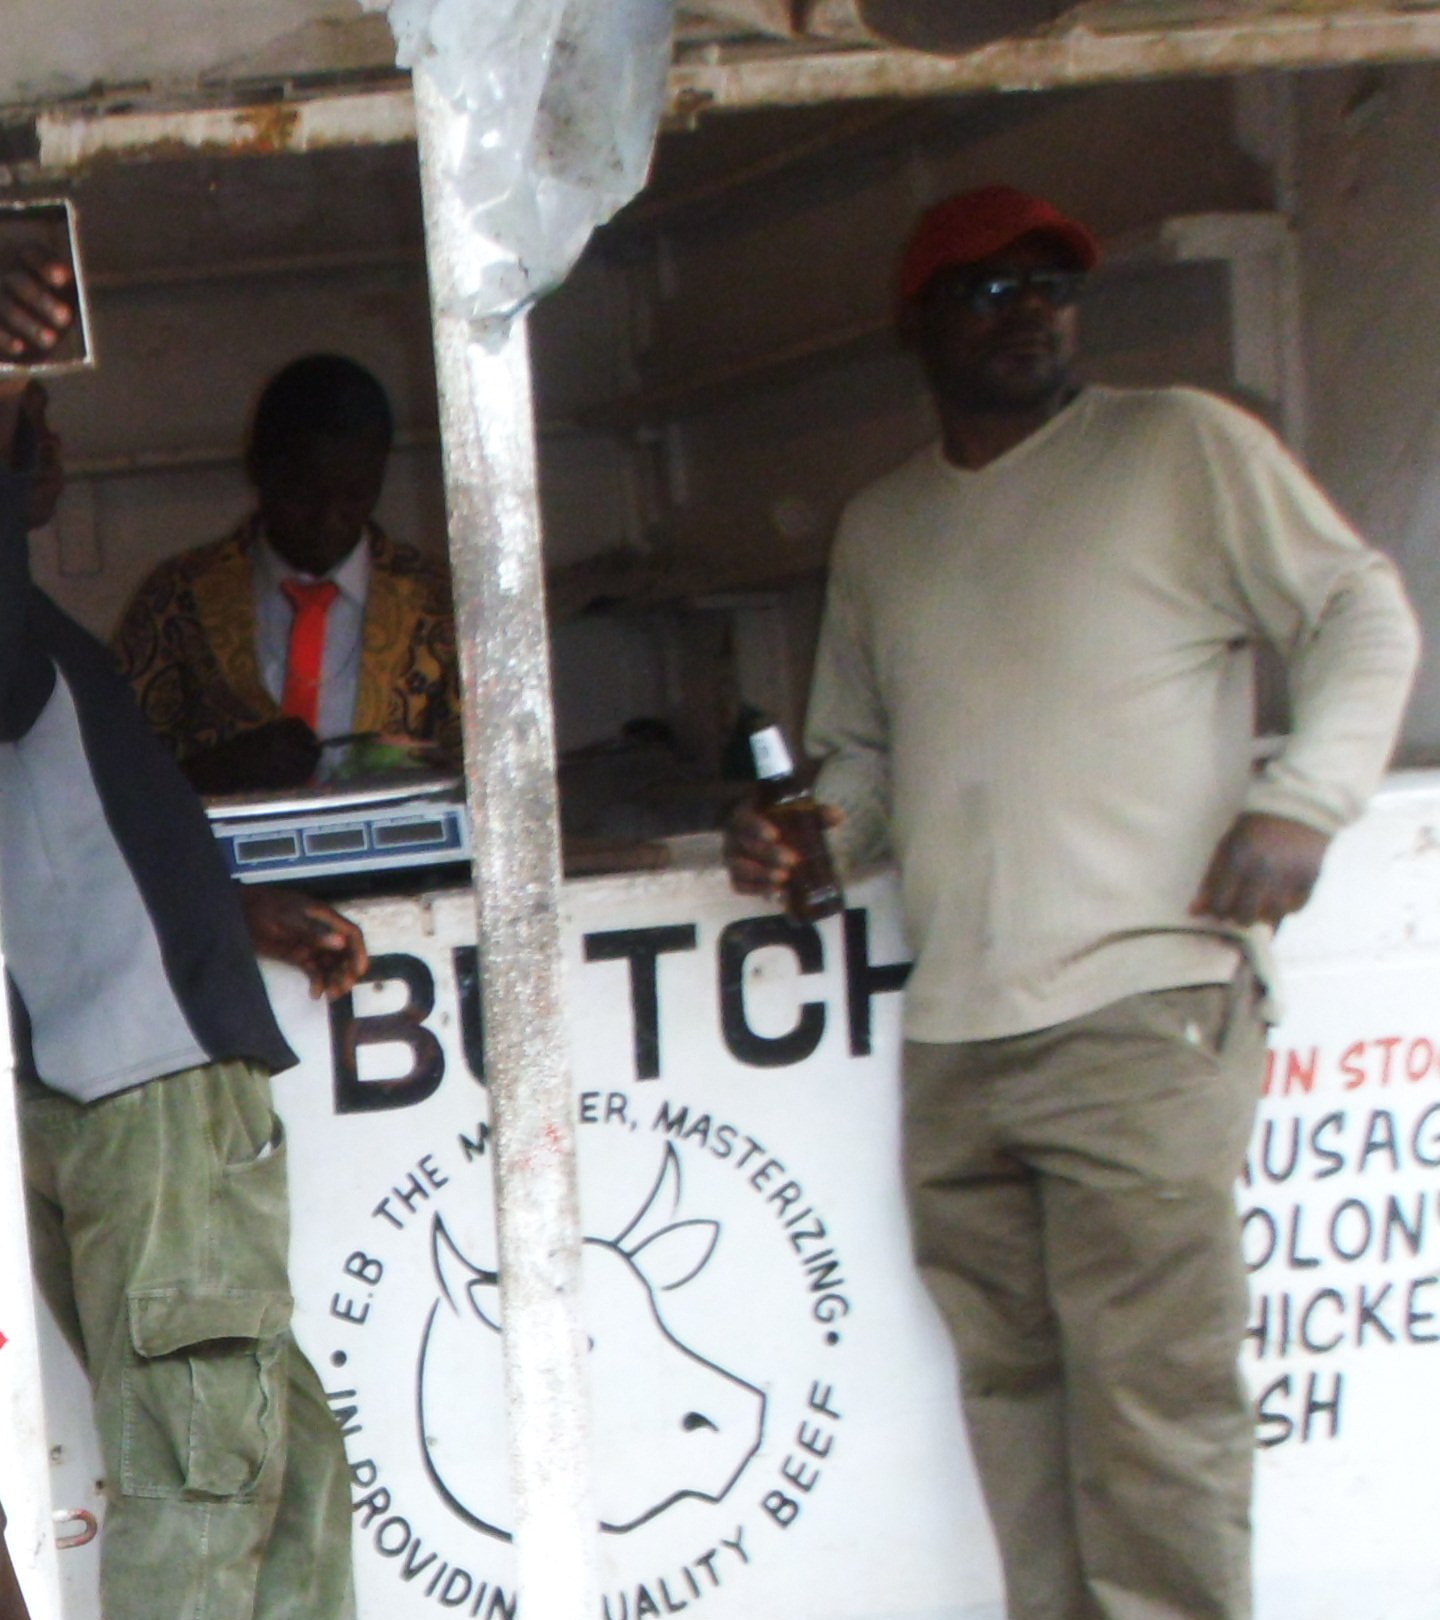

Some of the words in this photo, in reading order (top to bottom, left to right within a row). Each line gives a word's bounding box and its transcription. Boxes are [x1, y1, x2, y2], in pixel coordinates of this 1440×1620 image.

[1261, 1046, 1318, 1096] IN
[1339, 1036, 1440, 1091] STO
[1239, 1101, 1440, 1188] USAG
[371, 1153, 450, 1230] THE
[1239, 1191, 1440, 1272] OLON
[759, 1379, 842, 1530] BEEF
